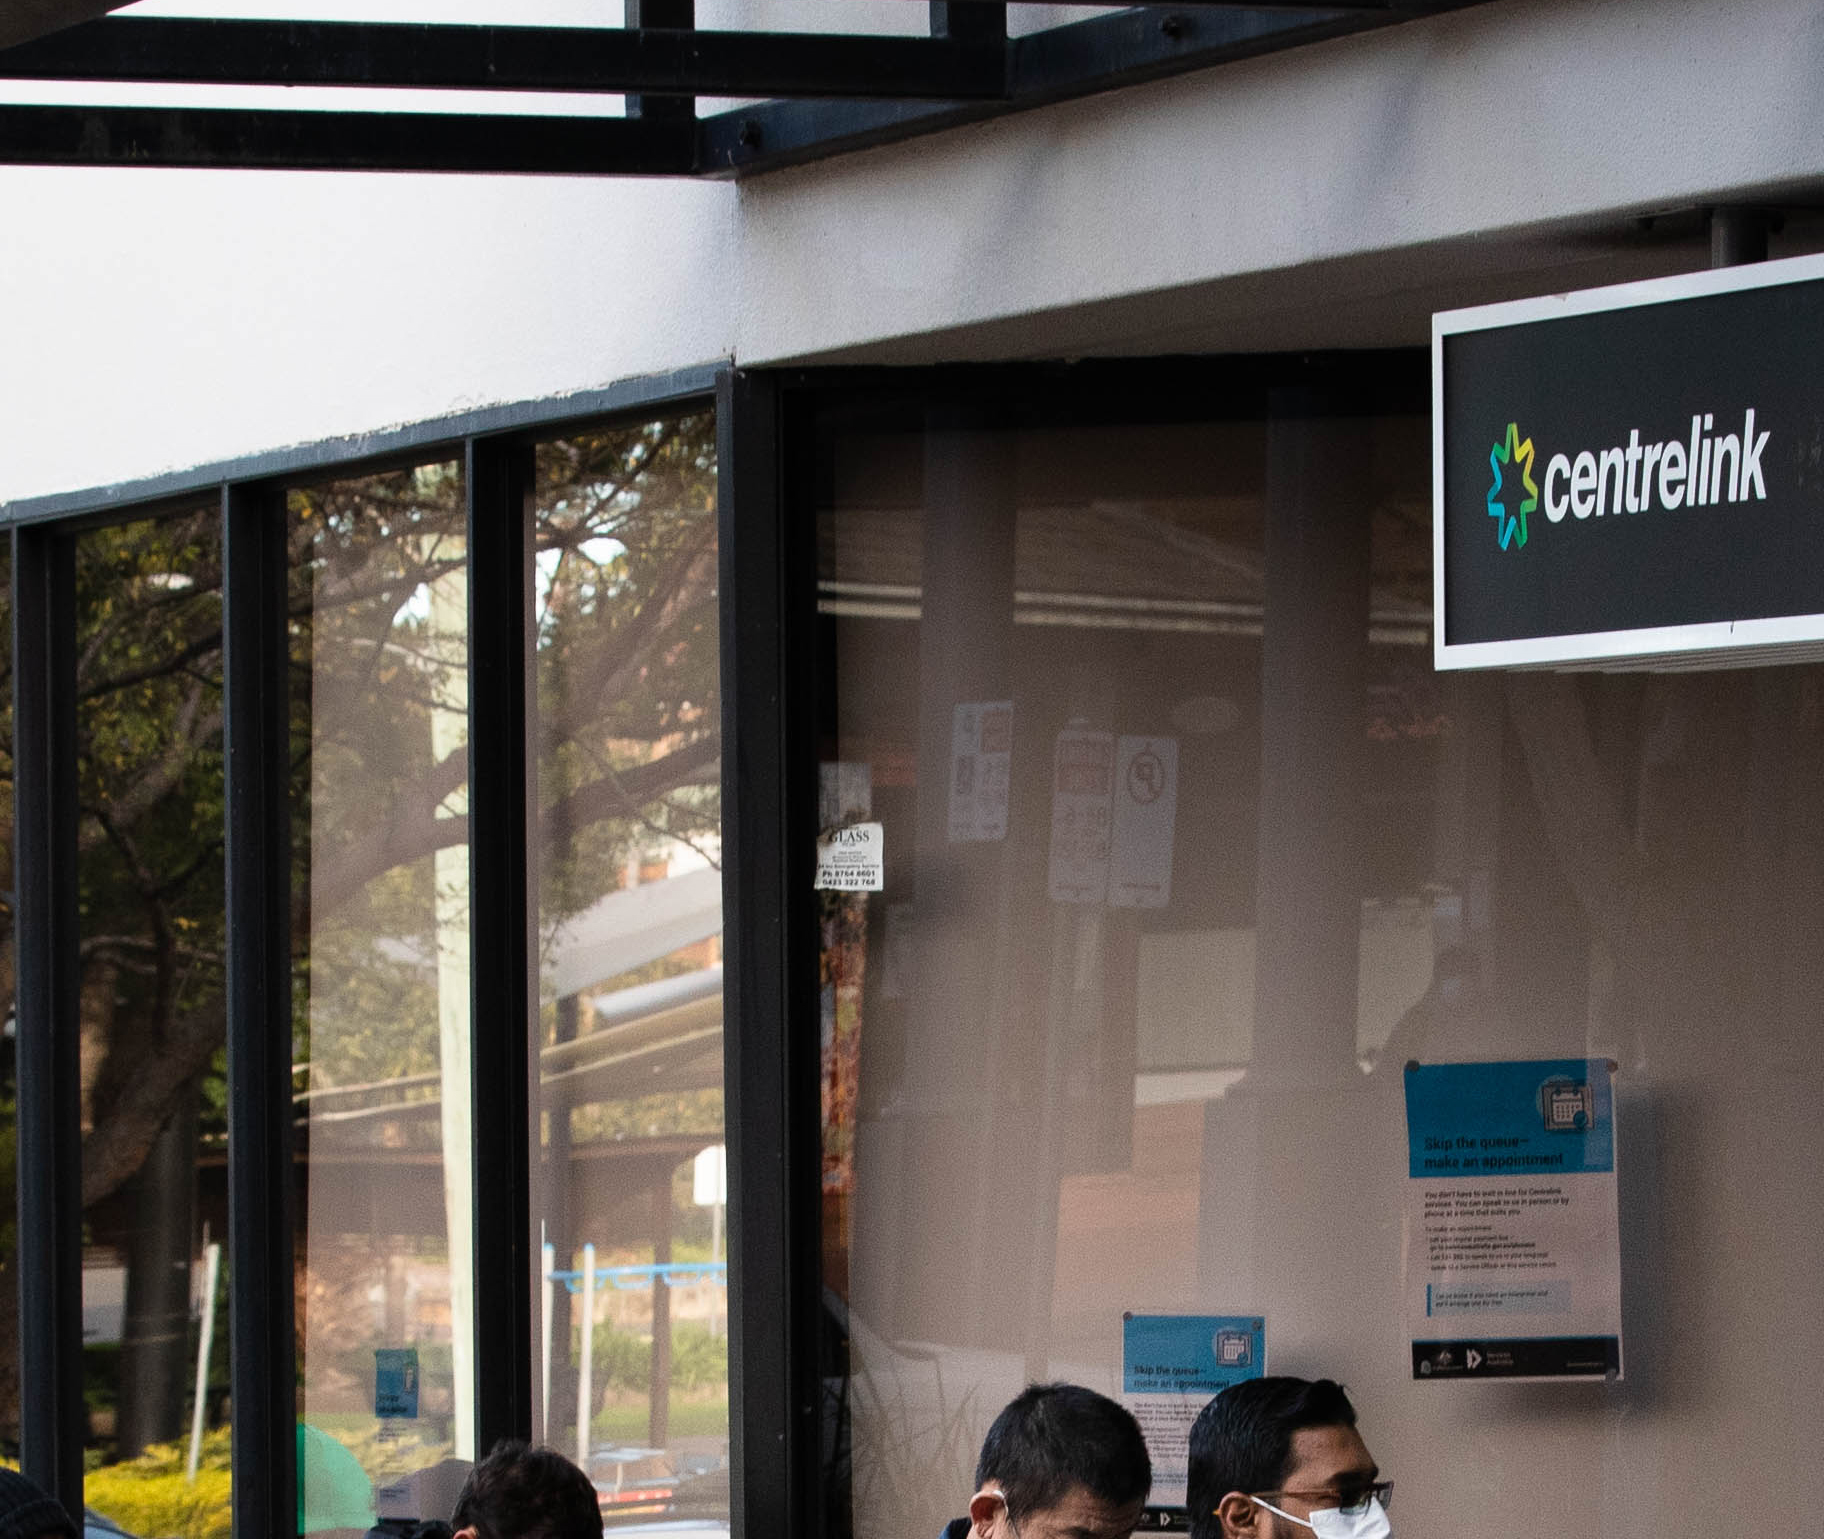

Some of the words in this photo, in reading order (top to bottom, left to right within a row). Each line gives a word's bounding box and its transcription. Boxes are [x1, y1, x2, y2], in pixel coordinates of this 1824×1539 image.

[1543, 408, 1771, 522] centrelink
[1425, 1138, 1453, 1151] Skip
[1456, 1136, 1475, 1149] the
[1425, 1155, 1459, 1169] make
[1463, 1157, 1479, 1168] an
[1482, 1153, 1563, 1169] appointment
